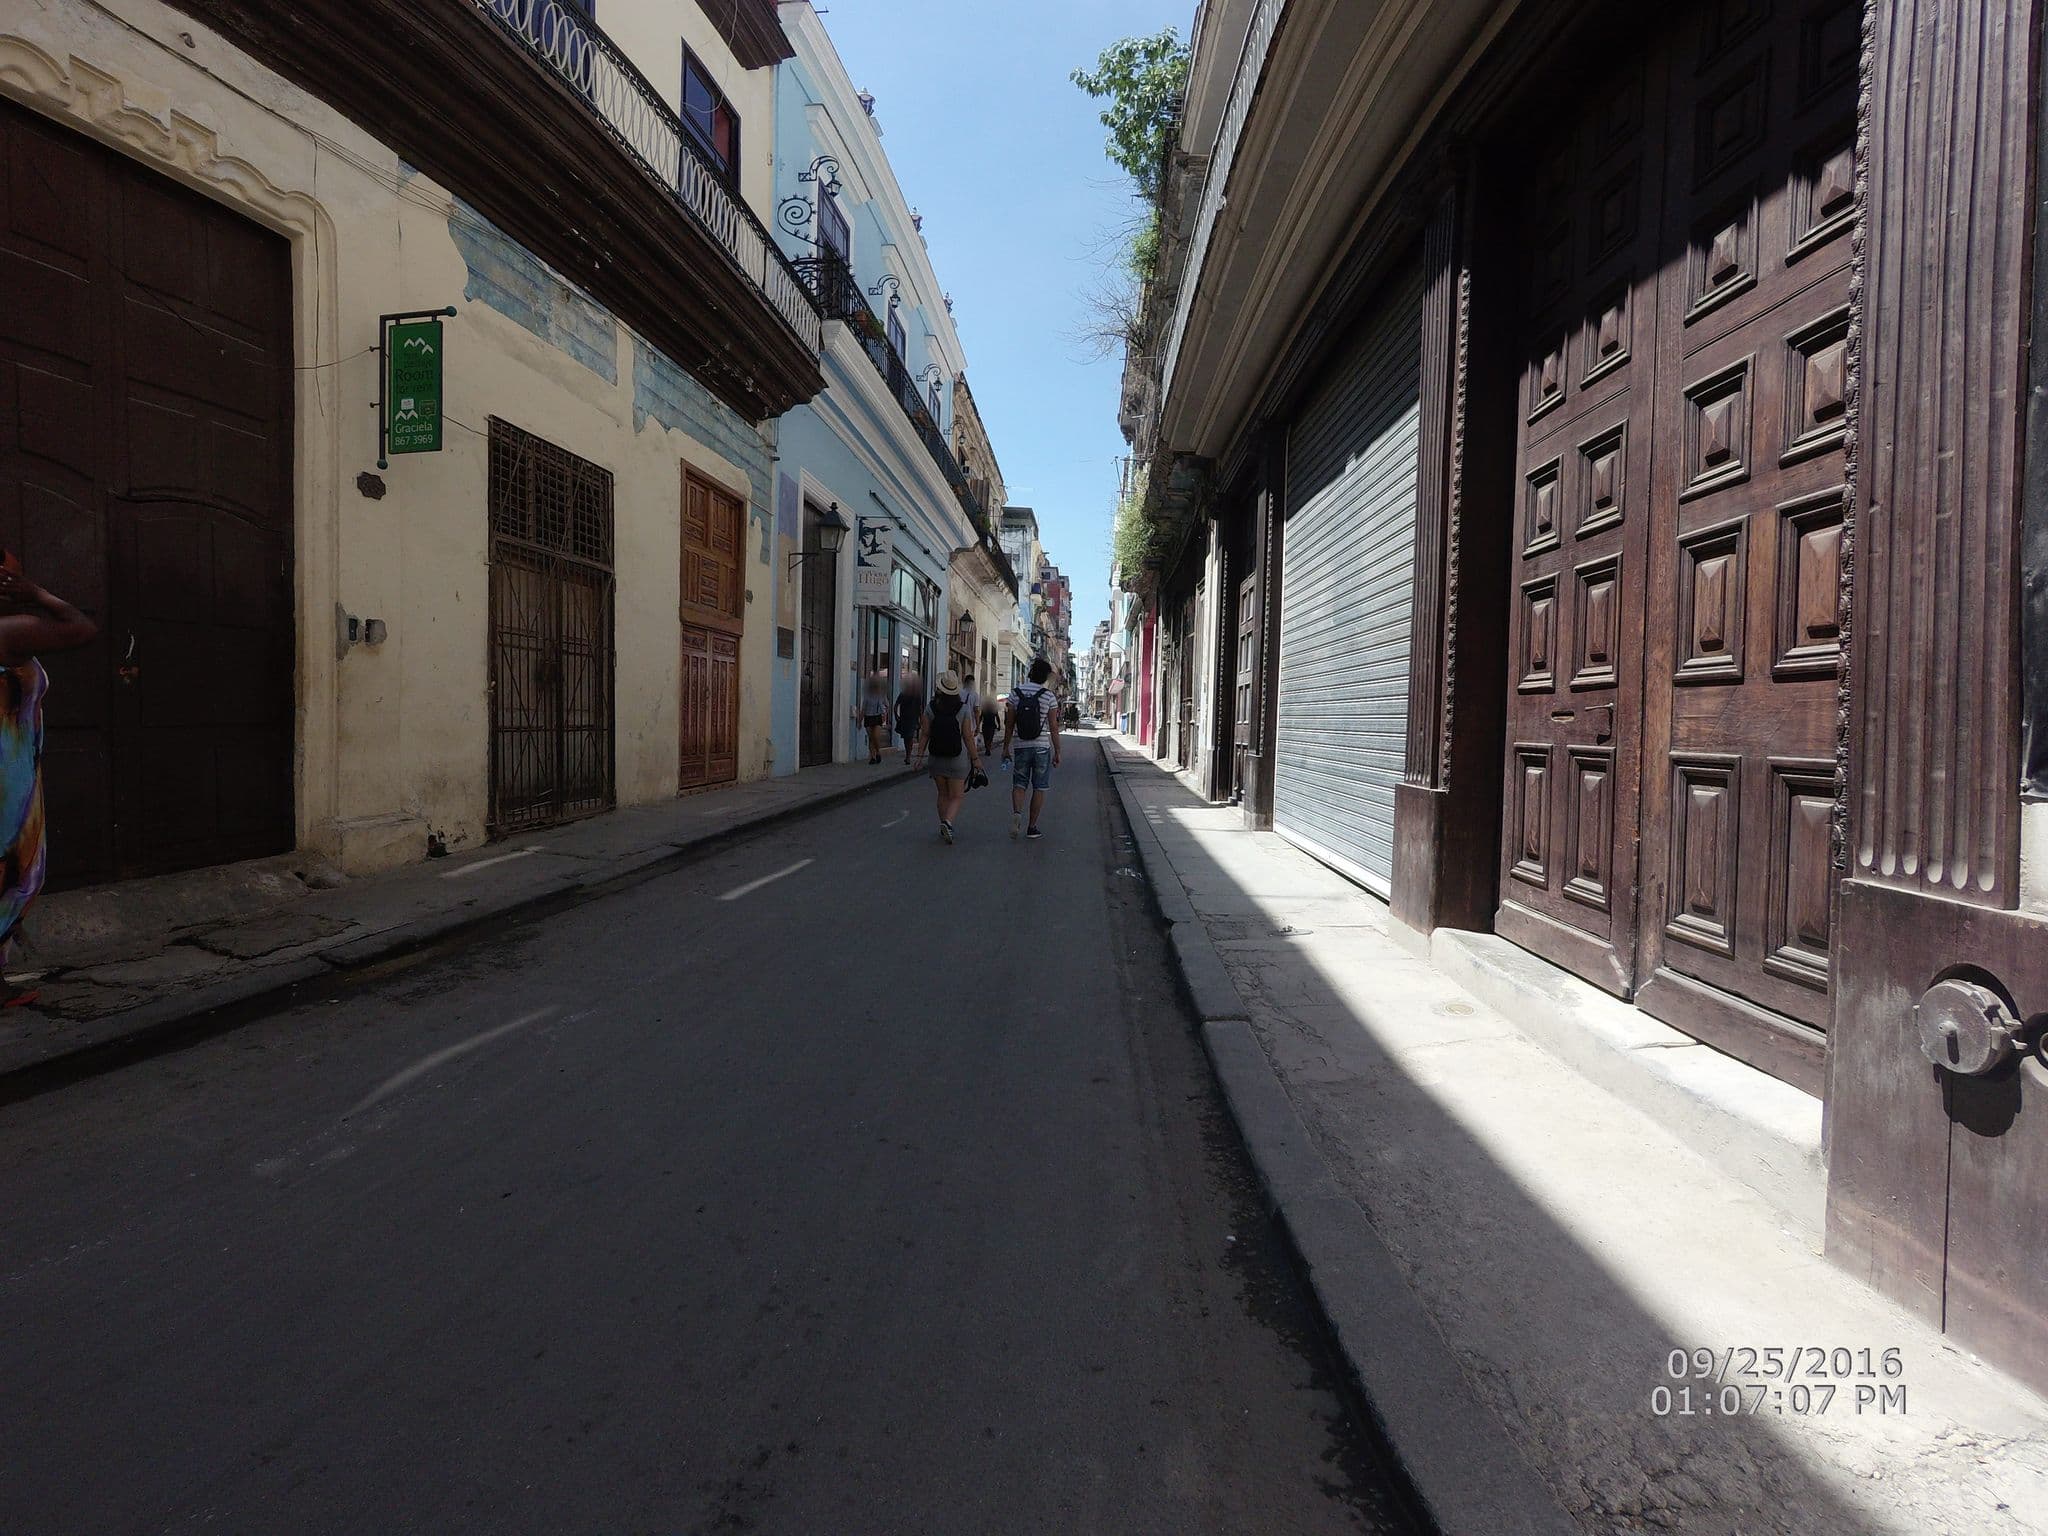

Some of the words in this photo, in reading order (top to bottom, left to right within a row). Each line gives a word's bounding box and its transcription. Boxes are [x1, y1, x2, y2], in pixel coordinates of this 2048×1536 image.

[396, 368, 433, 382] Room
[395, 422, 433, 434] Graciela
[394, 436, 410, 446] 867
[413, 434, 433, 445] 3969
